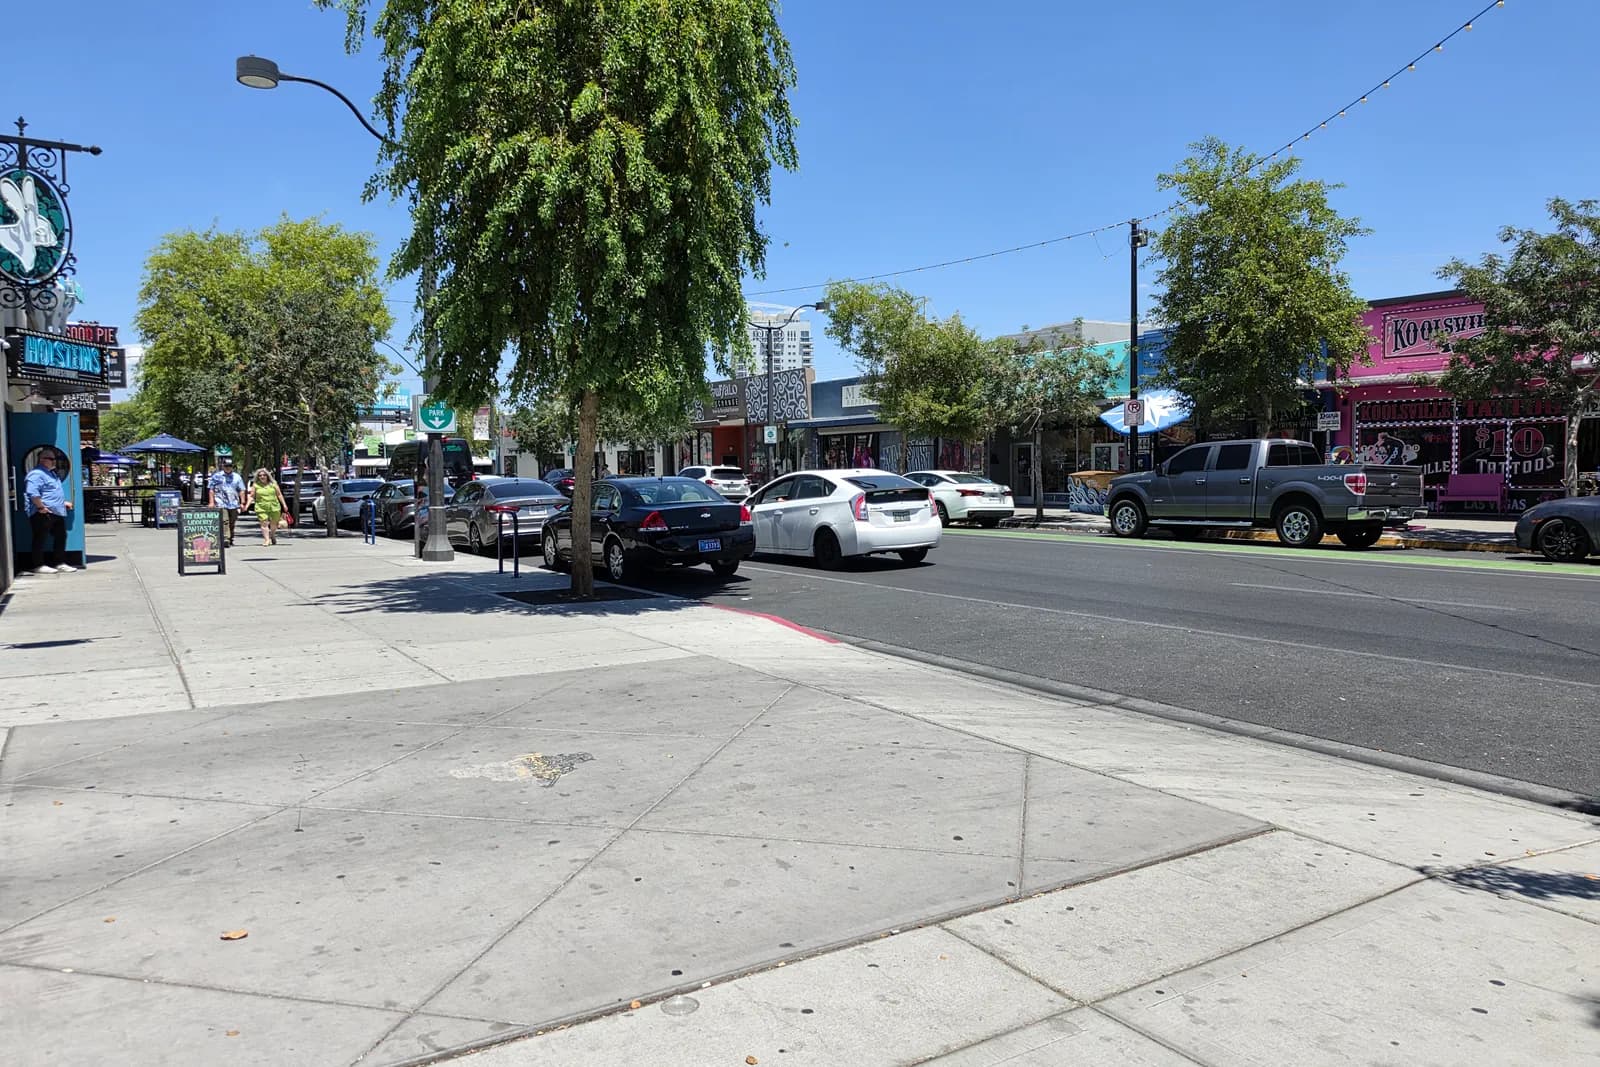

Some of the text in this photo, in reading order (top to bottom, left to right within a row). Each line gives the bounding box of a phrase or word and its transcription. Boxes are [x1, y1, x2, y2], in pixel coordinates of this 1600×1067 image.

[96, 328, 115, 343] PIE
[1392, 313, 1487, 352] KOOLSVIL
[25, 335, 102, 375] HOLSTEINS
[60, 400, 97, 410] COCKTAILS
[428, 409, 444, 417] PARK
[1475, 424, 1545, 458] $10
[1476, 455, 1555, 475] TATTOOS
